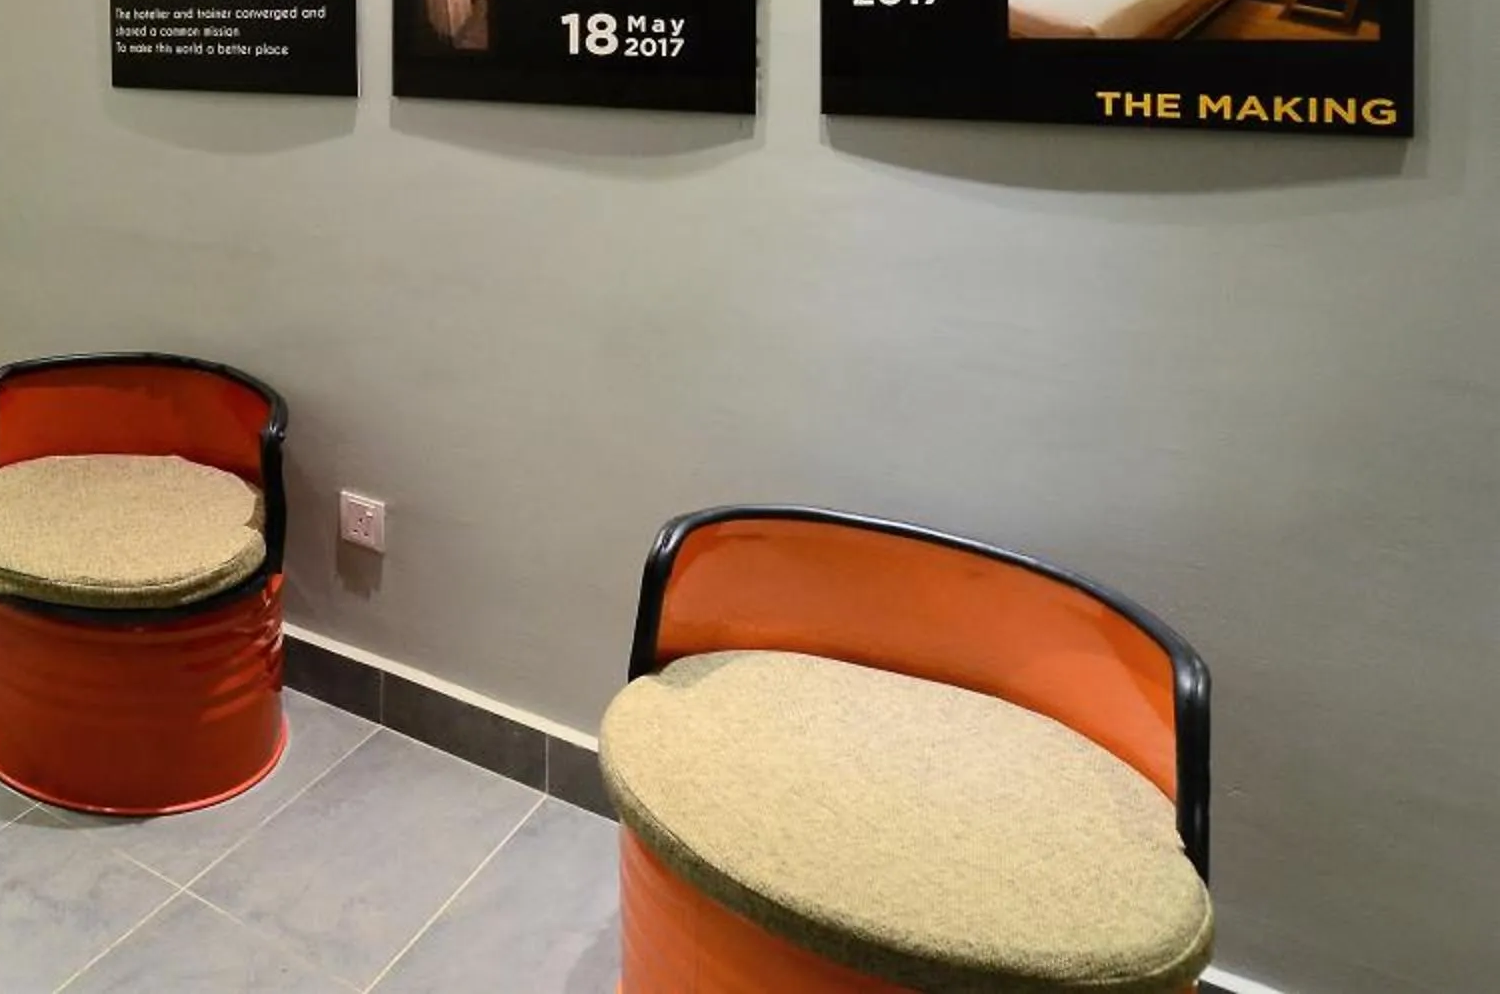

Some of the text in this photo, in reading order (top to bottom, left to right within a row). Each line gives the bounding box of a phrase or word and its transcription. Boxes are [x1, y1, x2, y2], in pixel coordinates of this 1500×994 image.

[235, 6, 326, 21] converged and
[561, 13, 619, 56] 18
[628, 15, 685, 37] May
[217, 43, 289, 57] better place
[624, 38, 685, 57] 2017
[1096, 92, 1396, 125] THE MAKING
